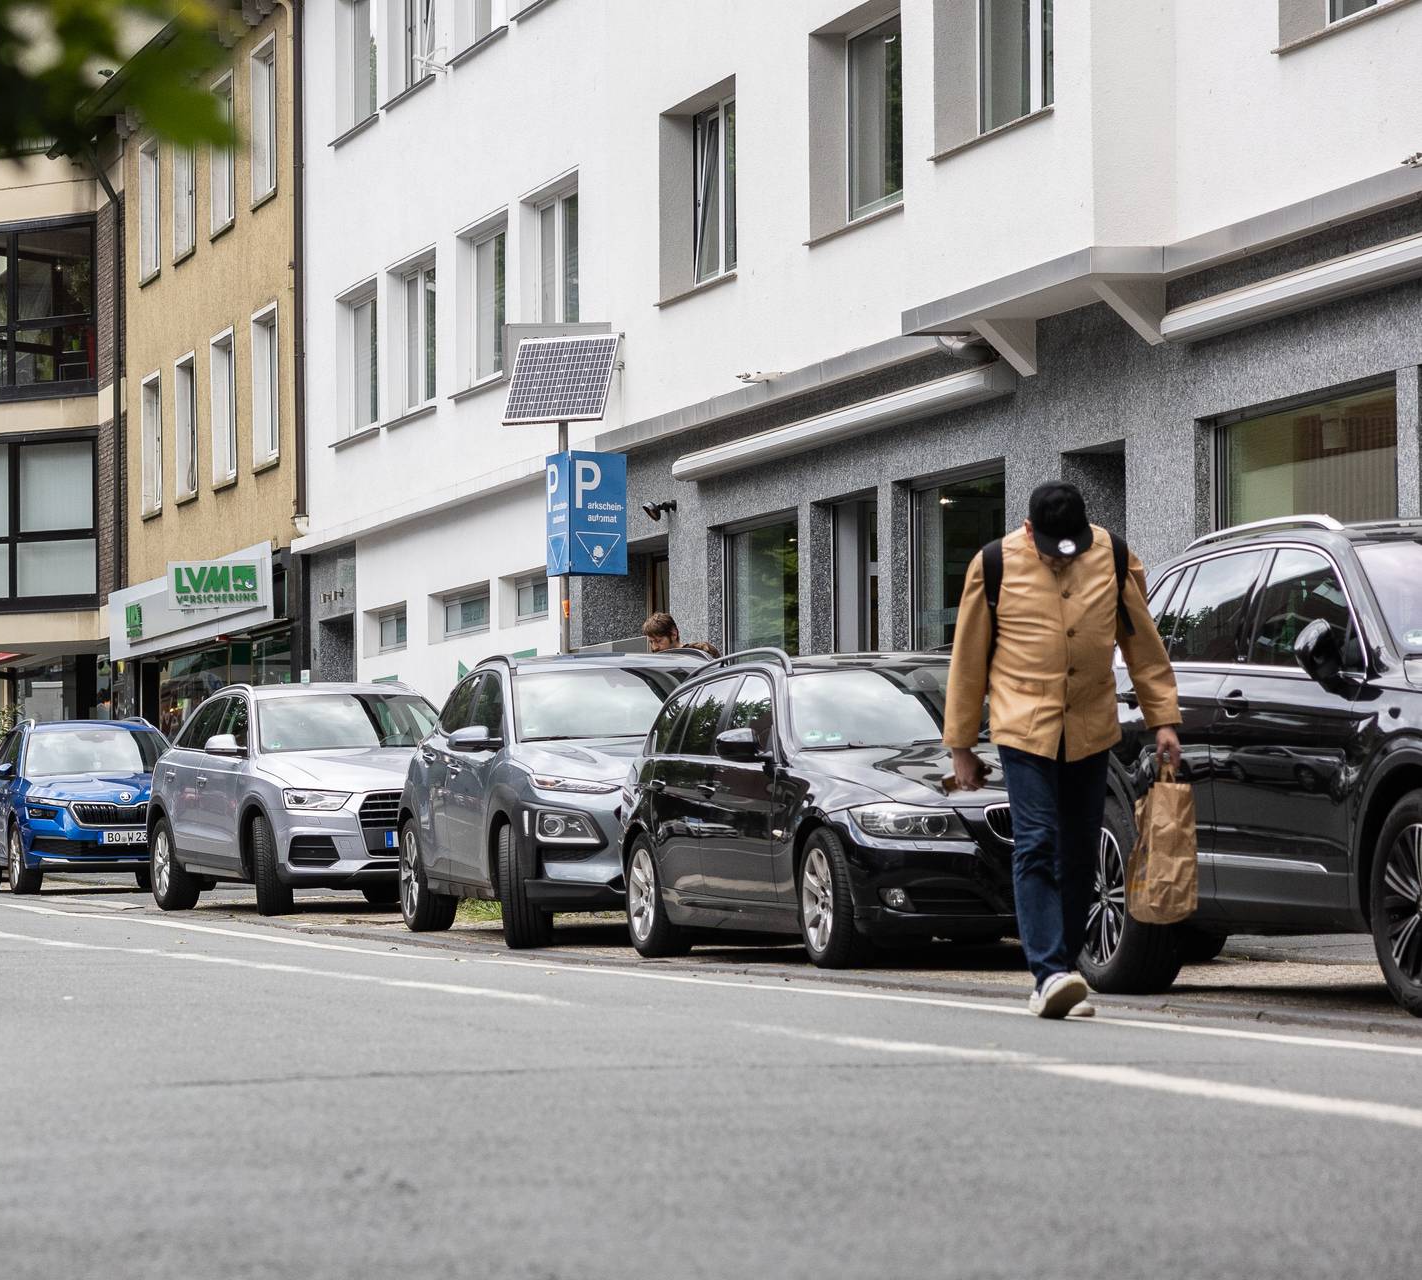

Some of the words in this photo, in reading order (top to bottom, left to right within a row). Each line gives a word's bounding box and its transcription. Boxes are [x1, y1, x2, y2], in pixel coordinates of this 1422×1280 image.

[575, 459, 601, 508] P
[587, 514, 618, 524] automat
[174, 565, 230, 594] LVM
[175, 592, 259, 605] VERSICHERUNG
[107, 832, 121, 842] BO
[127, 832, 134, 842] W
